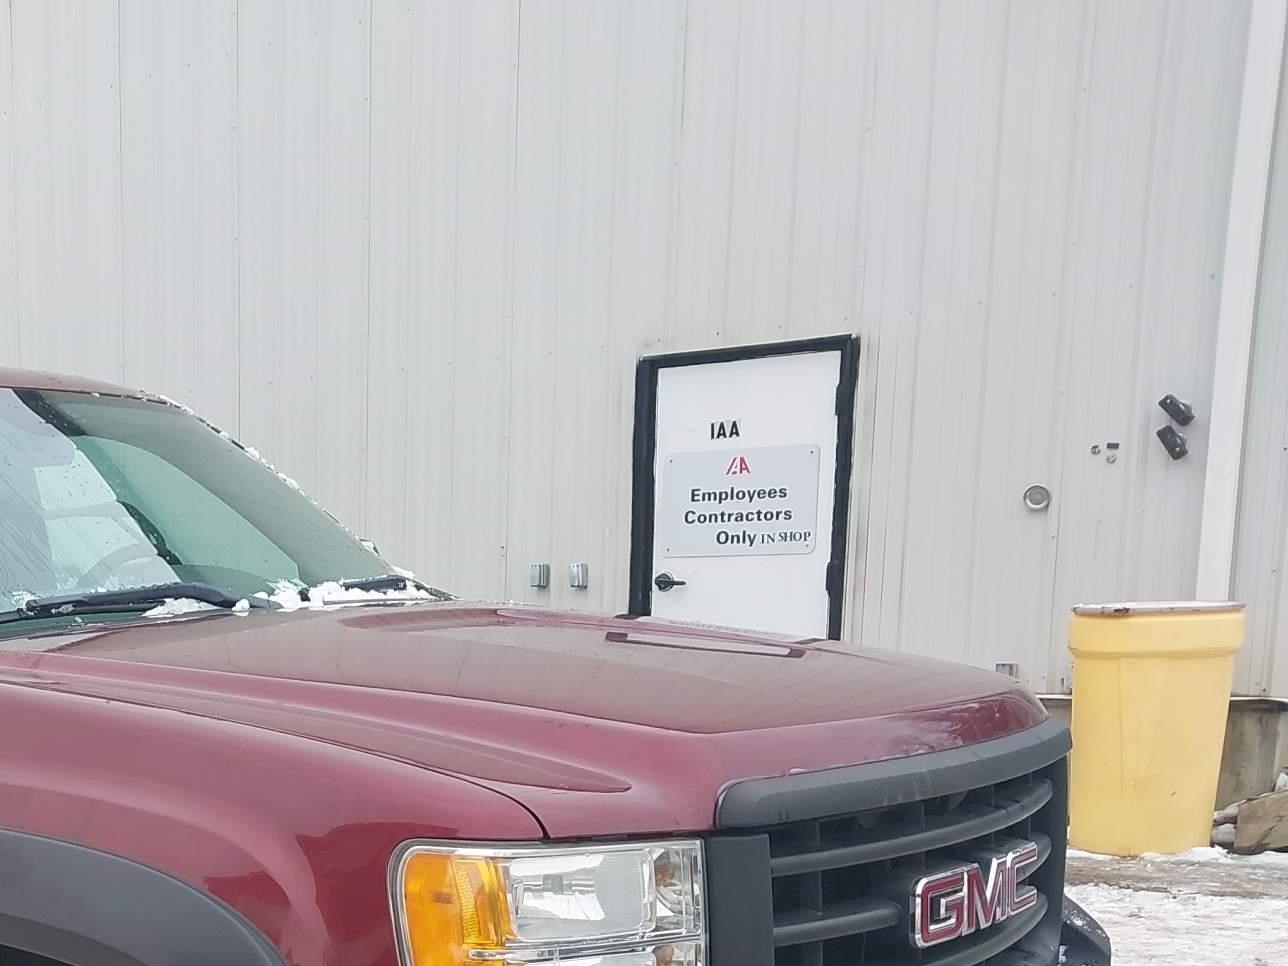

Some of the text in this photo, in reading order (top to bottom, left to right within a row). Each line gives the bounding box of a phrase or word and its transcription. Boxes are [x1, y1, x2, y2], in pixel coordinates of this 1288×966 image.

[710, 420, 740, 440] IAA
[690, 486, 788, 505] Employees
[684, 509, 792, 524] Contractors
[716, 530, 811, 547] Only IN SHOP
[915, 842, 1038, 949] GMC
